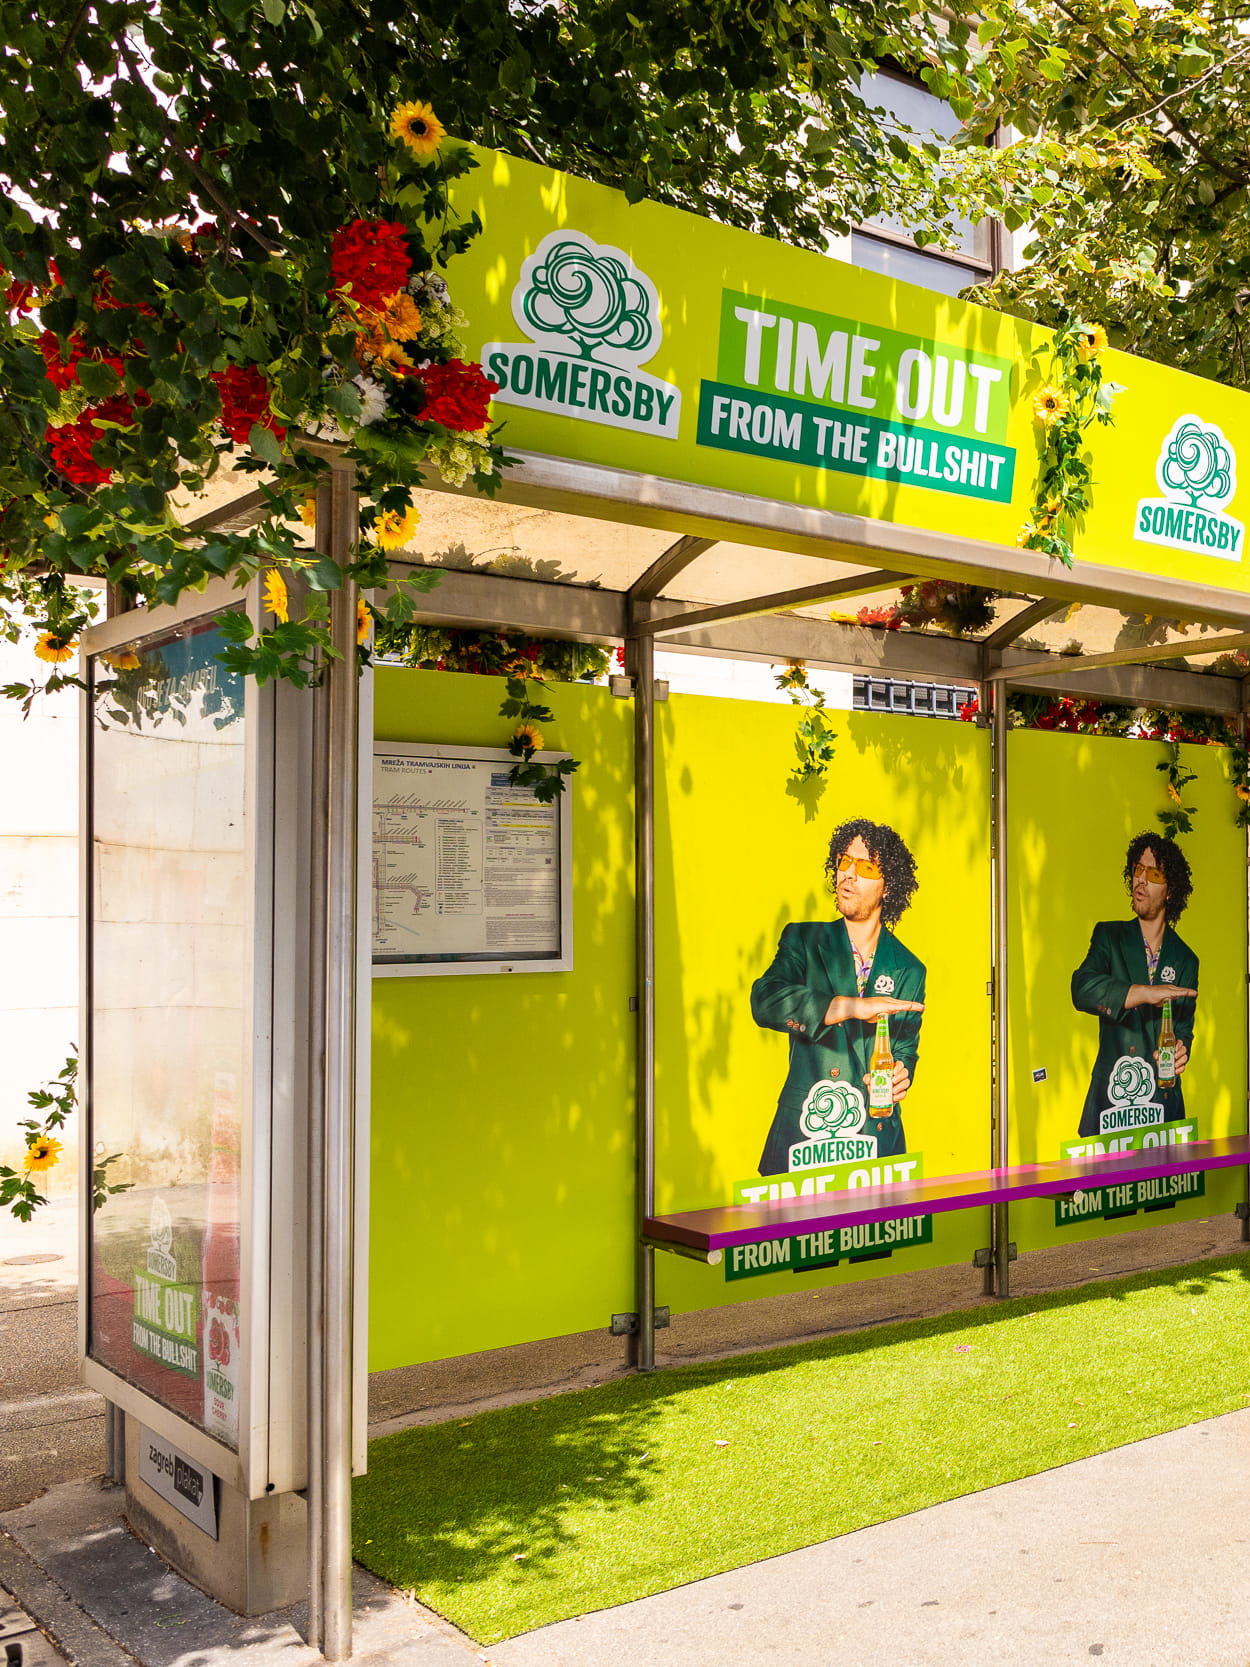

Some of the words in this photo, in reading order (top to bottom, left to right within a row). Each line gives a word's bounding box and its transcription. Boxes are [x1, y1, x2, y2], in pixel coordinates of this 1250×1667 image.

[488, 353, 675, 426] SOMERSBY
[734, 305, 881, 409] TIME
[898, 347, 1002, 433] OUT
[710, 394, 802, 451] FROM
[813, 415, 868, 464] THE
[877, 431, 1006, 491] BULLSHIT
[1139, 505, 1241, 552] SOMERSBY
[381, 758, 405, 766] MREŽA
[407, 760, 450, 769] TRAMVAJSKIH
[1102, 1107, 1162, 1130] SOMERSBY
[792, 1140, 874, 1166] SOMERSBY
[1106, 1184, 1134, 1208] THE
[1138, 1171, 1200, 1202] BULLSHIT
[732, 1238, 791, 1272] FROM
[797, 1230, 834, 1259] THE
[840, 1215, 926, 1252] BULLSHIT
[136, 1274, 161, 1326] TIME
[165, 1287, 193, 1336] OUT
[133, 1322, 148, 1351] FROM
[149, 1331, 161, 1358] THE
[162, 1338, 197, 1373] BULLSHIT
[149, 1445, 173, 1477] zagreb
